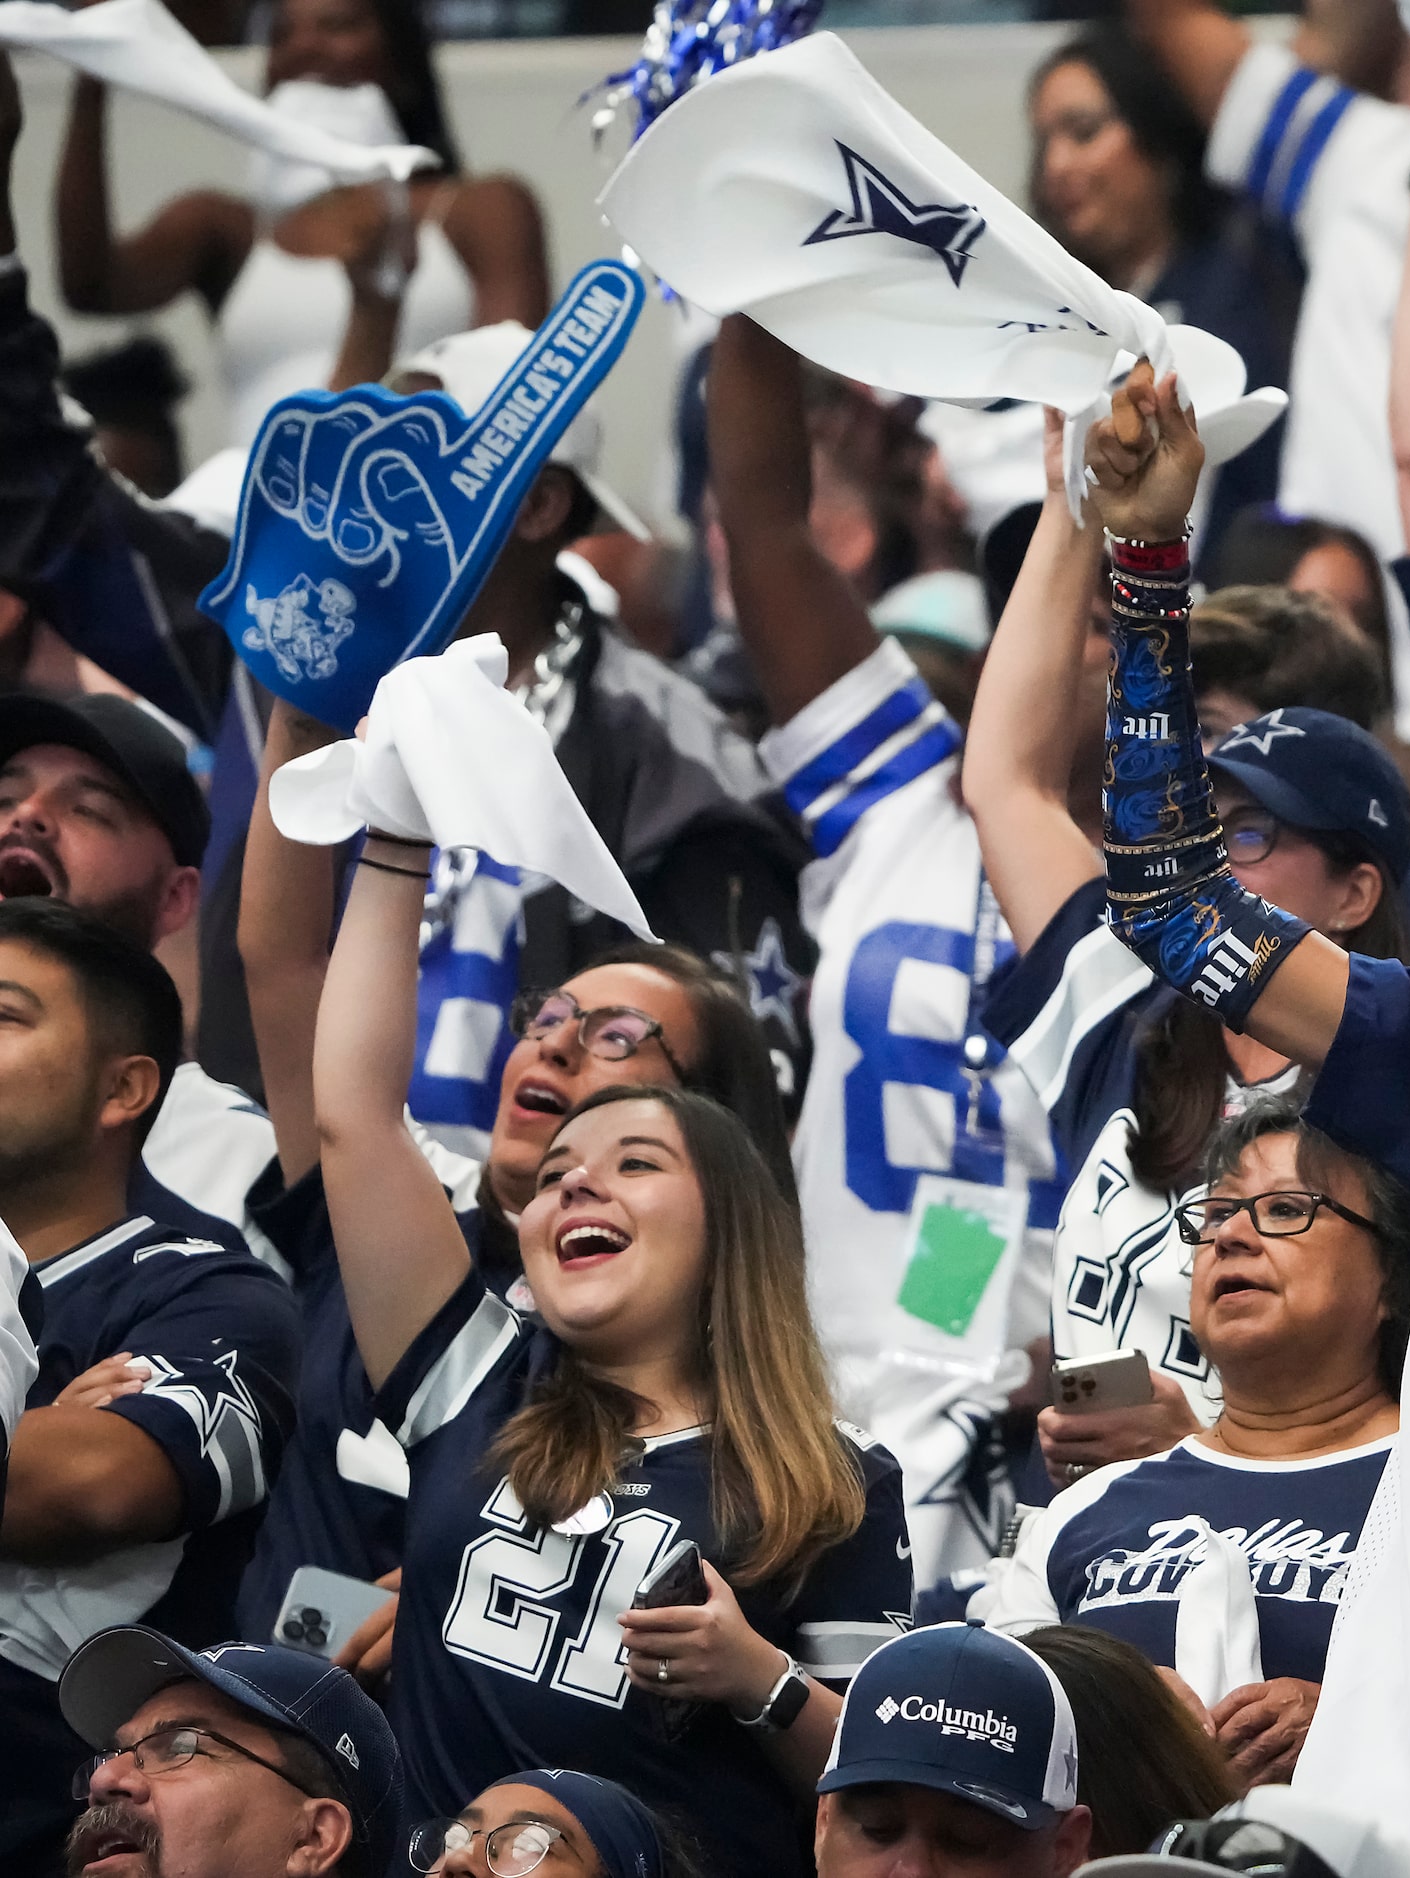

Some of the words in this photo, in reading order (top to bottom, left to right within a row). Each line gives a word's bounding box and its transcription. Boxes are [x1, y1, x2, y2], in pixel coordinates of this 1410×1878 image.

[450, 348, 575, 500] AMERICA'S
[553, 284, 623, 358] TEAM
[1122, 712, 1171, 740] Lite
[1144, 856, 1180, 878] Lite
[1191, 926, 1258, 1007] Lite
[843, 917, 1060, 1230] 8
[441, 1473, 682, 1710] 21
[900, 1695, 1018, 1742] Columbia
[940, 1723, 1015, 1754] PFG
